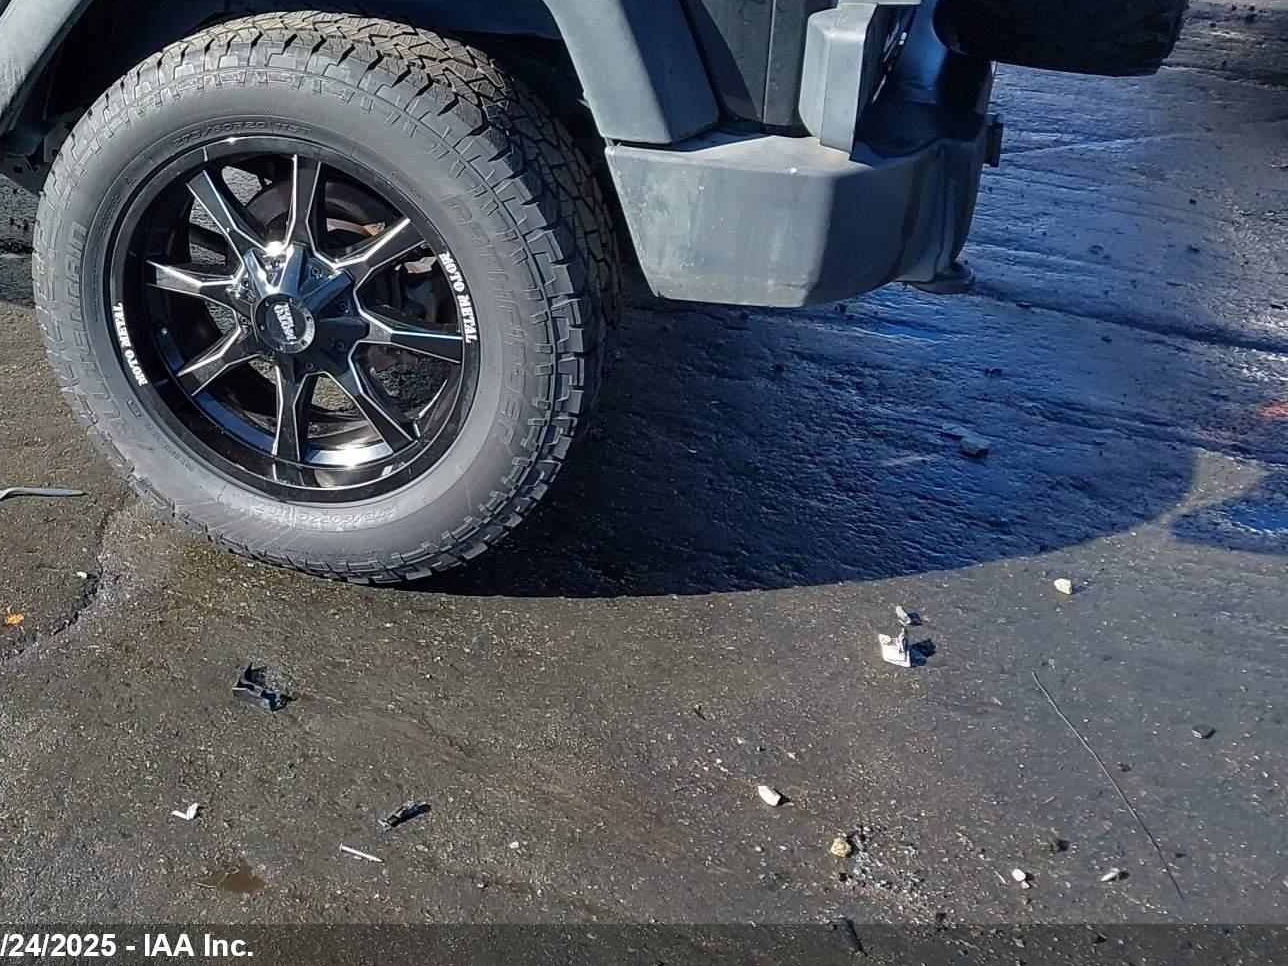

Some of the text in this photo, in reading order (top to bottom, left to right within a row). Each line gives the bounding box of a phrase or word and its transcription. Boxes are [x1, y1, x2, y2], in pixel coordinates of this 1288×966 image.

[439, 251, 477, 343] MOTO METAL
[113, 302, 132, 347] METAL
[125, 349, 148, 386] MOTO
